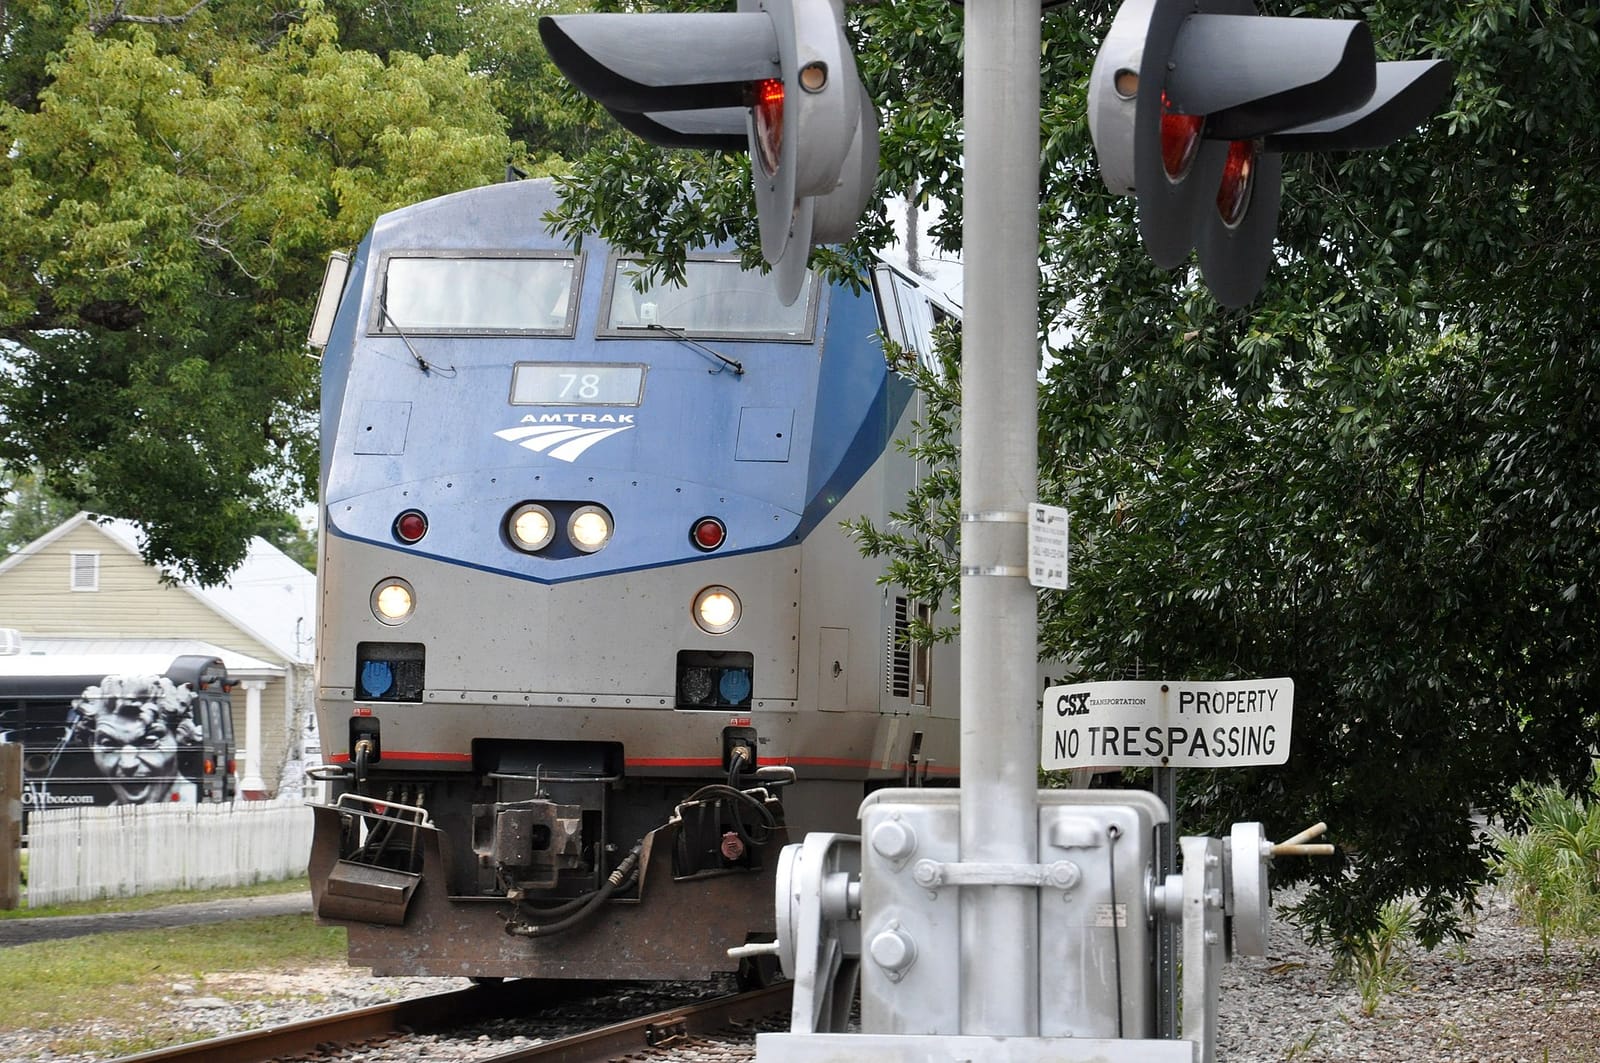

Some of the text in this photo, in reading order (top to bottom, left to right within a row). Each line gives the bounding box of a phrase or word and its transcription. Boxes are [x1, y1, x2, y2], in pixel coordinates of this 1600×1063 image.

[559, 374, 600, 399] 78
[520, 414, 635, 423] AMTRAK
[1057, 689, 1279, 717] CSX TRANSPORTATION PROPERTY
[1055, 724, 1276, 760] NO TRESPASSING
